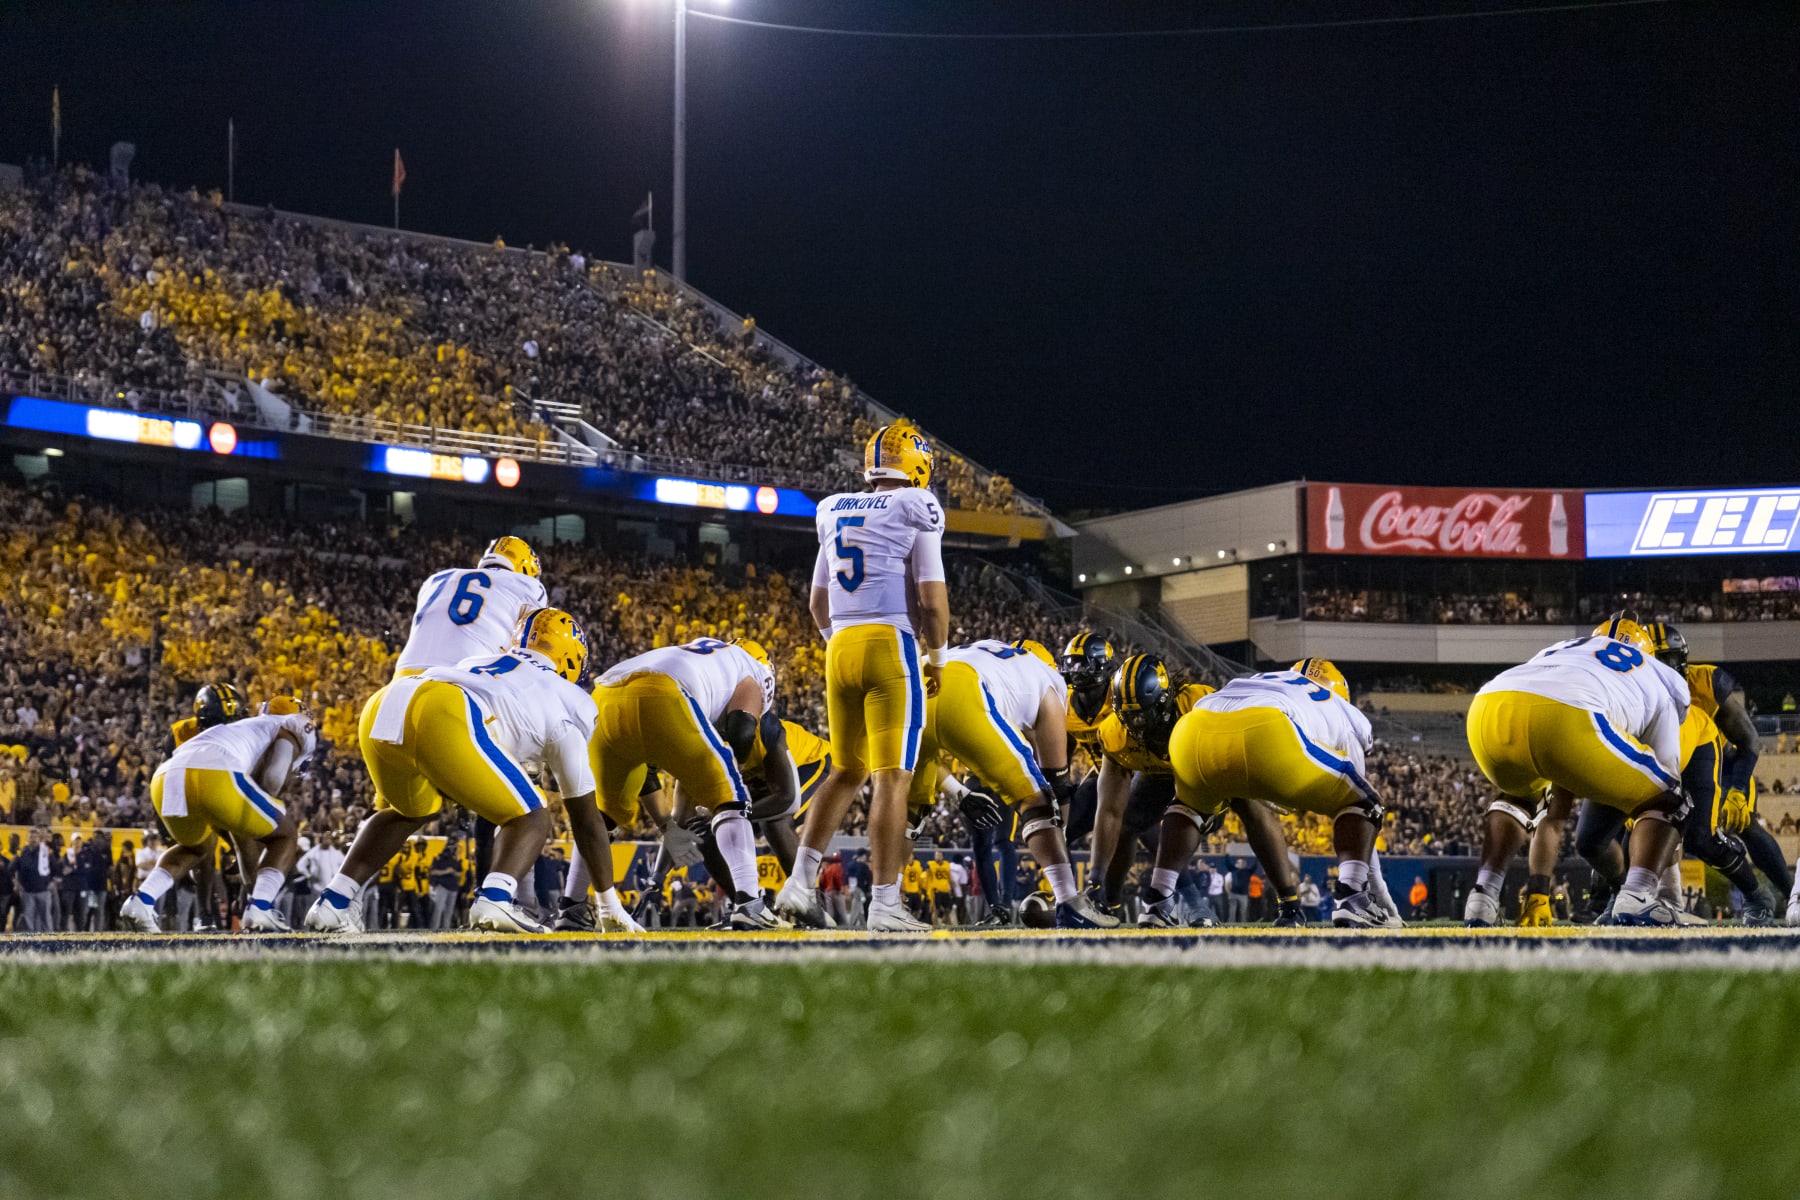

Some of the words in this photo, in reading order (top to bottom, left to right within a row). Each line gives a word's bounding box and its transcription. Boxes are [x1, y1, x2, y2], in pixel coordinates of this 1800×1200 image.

[830, 494, 893, 512] JURKOVEC
[926, 502, 940, 525] 5
[1359, 490, 1533, 551] Coca-Cola
[1639, 495, 1800, 548] CEC
[834, 515, 866, 593] 5
[415, 571, 492, 626] 76
[530, 631, 538, 642] 4
[1618, 632, 1631, 645] 78
[1307, 668, 1321, 679] 50
[759, 862, 777, 878] 87
